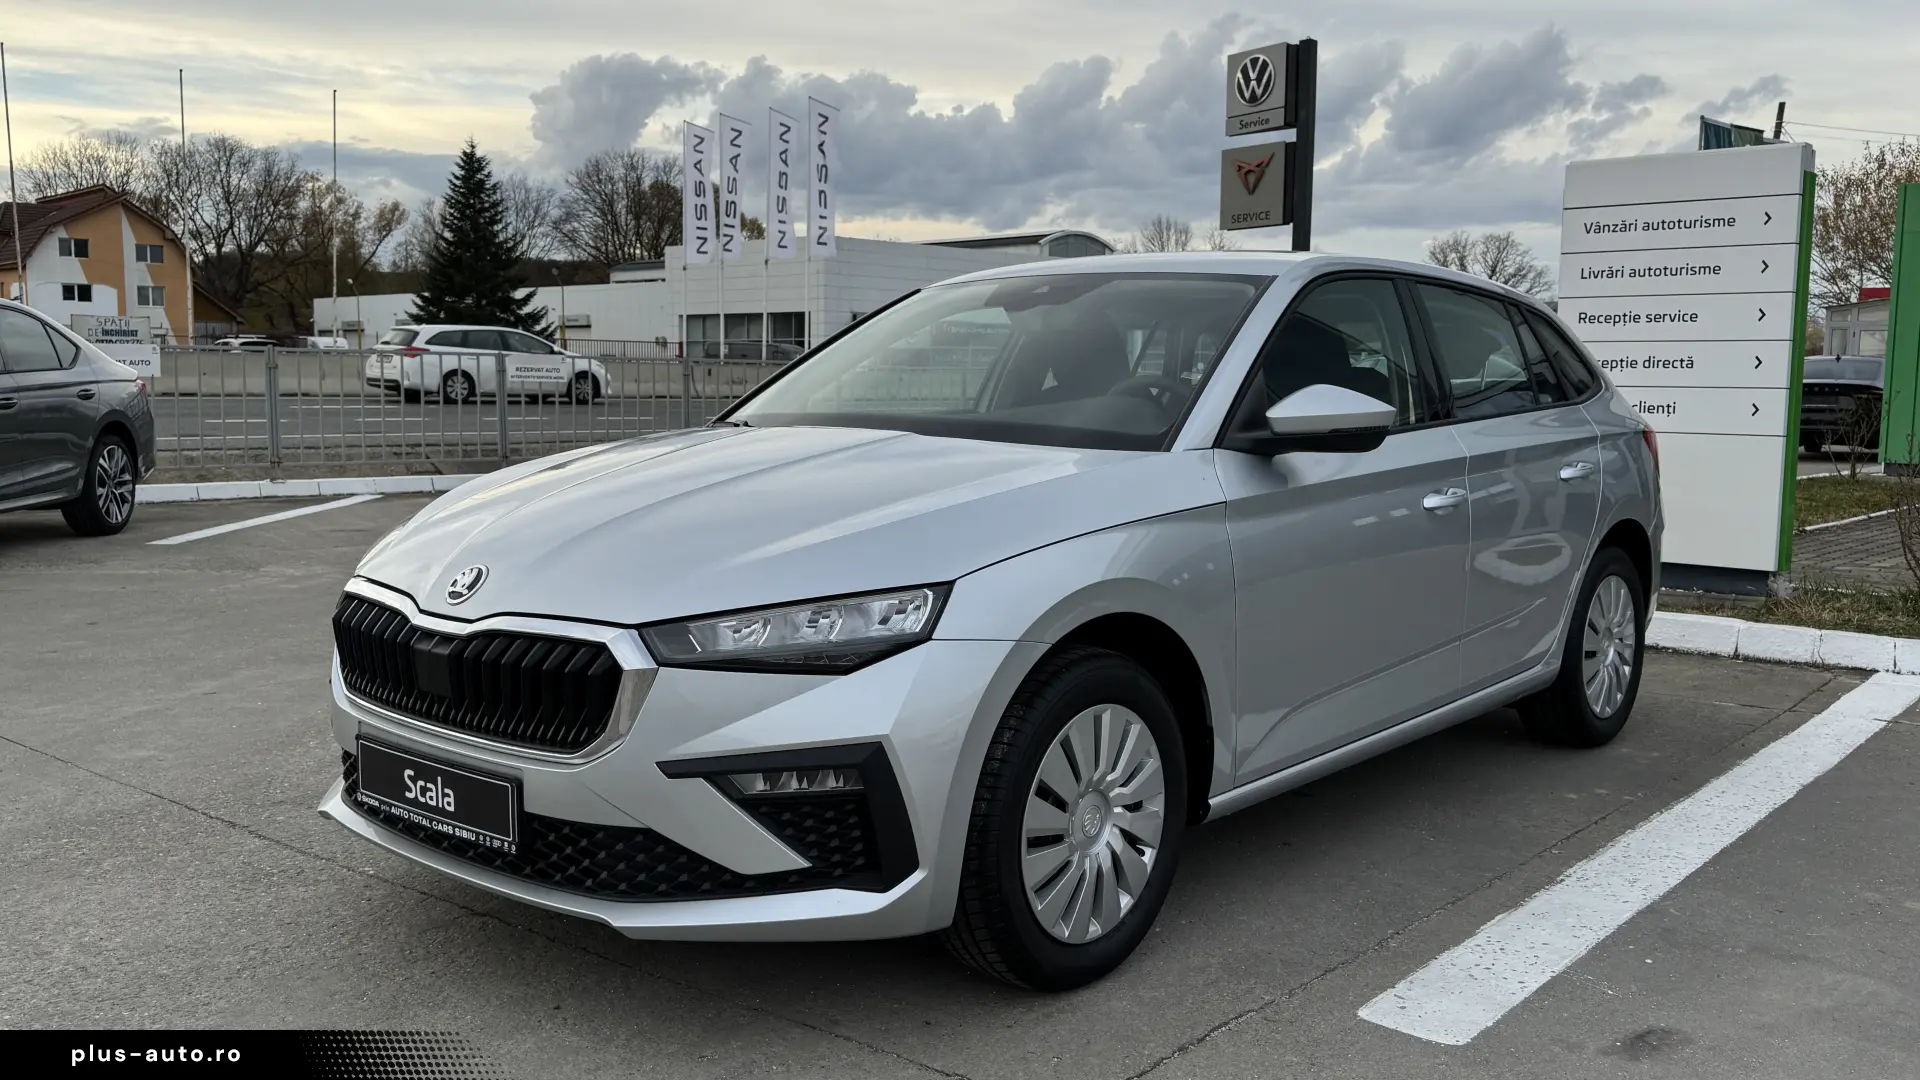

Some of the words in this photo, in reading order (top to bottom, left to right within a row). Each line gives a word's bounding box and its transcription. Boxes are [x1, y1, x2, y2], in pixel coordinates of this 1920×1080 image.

[1238, 117, 1270, 130] Service
[693, 134, 708, 255] NISSAN
[722, 127, 743, 252] NISSAN
[776, 122, 791, 249] NISSAN
[1231, 211, 1271, 224] SERVICE
[1584, 219, 1638, 235] Vânzări
[1642, 215, 1736, 232] autoturisme
[1581, 266, 1624, 280] Livrări
[1628, 263, 1722, 278] autoturisme
[1578, 311, 1641, 326] Recepție
[1645, 310, 1699, 323] service
[88, 328, 99, 337] DE
[1642, 356, 1694, 369] directă
[404, 768, 455, 812] Scala
[390, 805, 409, 819] AUTO
[409, 812, 431, 827] TOTAL
[432, 821, 454, 834] CARS
[454, 827, 476, 841] SIBIU
